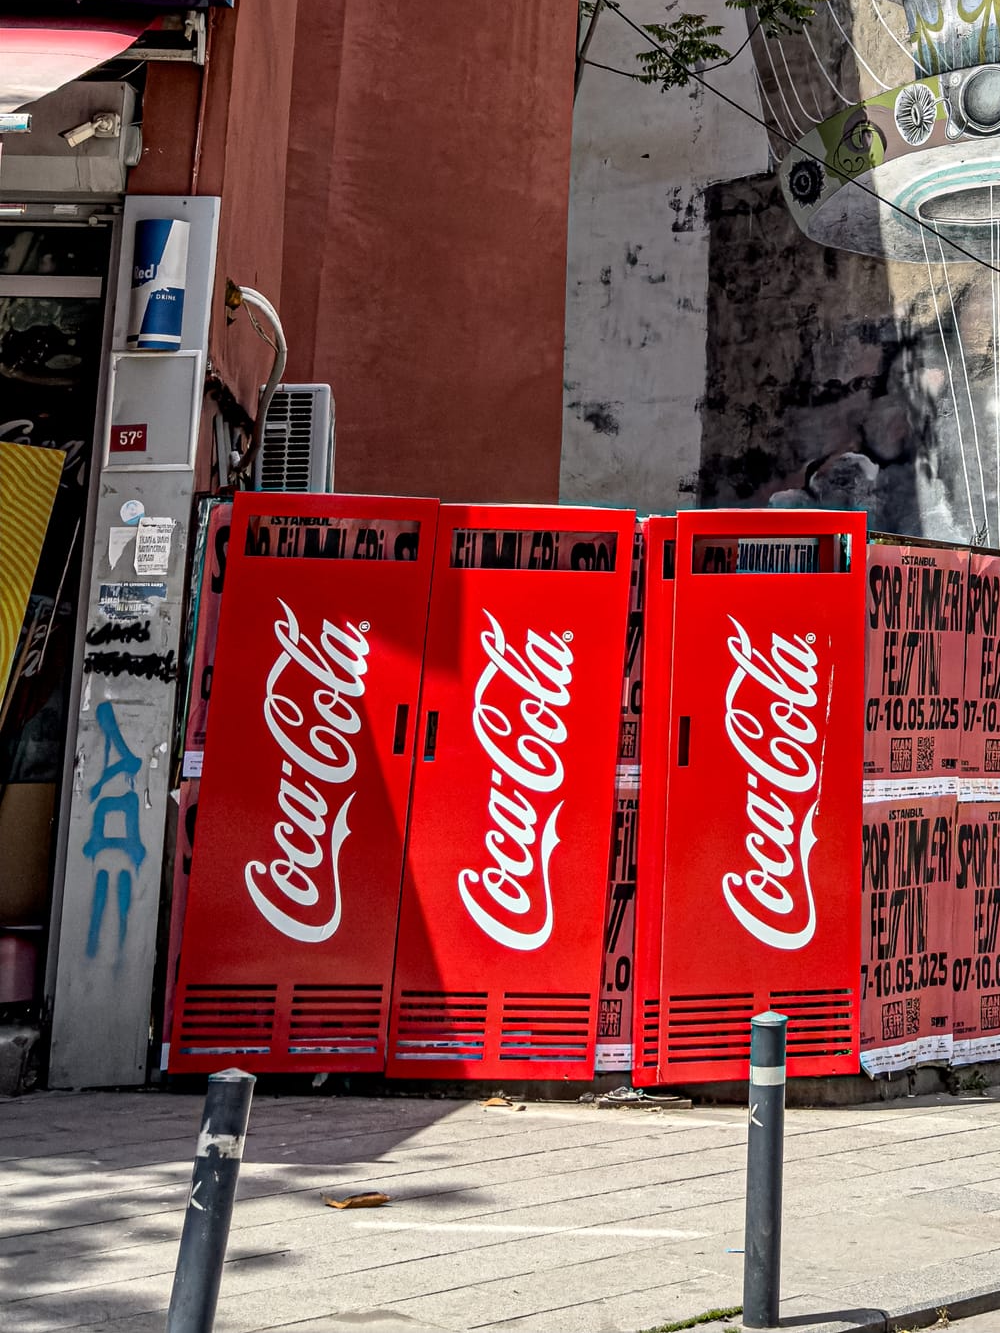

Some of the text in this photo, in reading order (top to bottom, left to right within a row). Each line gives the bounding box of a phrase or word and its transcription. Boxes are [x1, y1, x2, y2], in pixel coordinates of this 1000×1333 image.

[243, 595, 371, 944] Coca-Cola
[457, 607, 573, 952] Coca-Cola
[721, 613, 818, 950] Coca-Cola
[862, 822, 890, 892] POR
